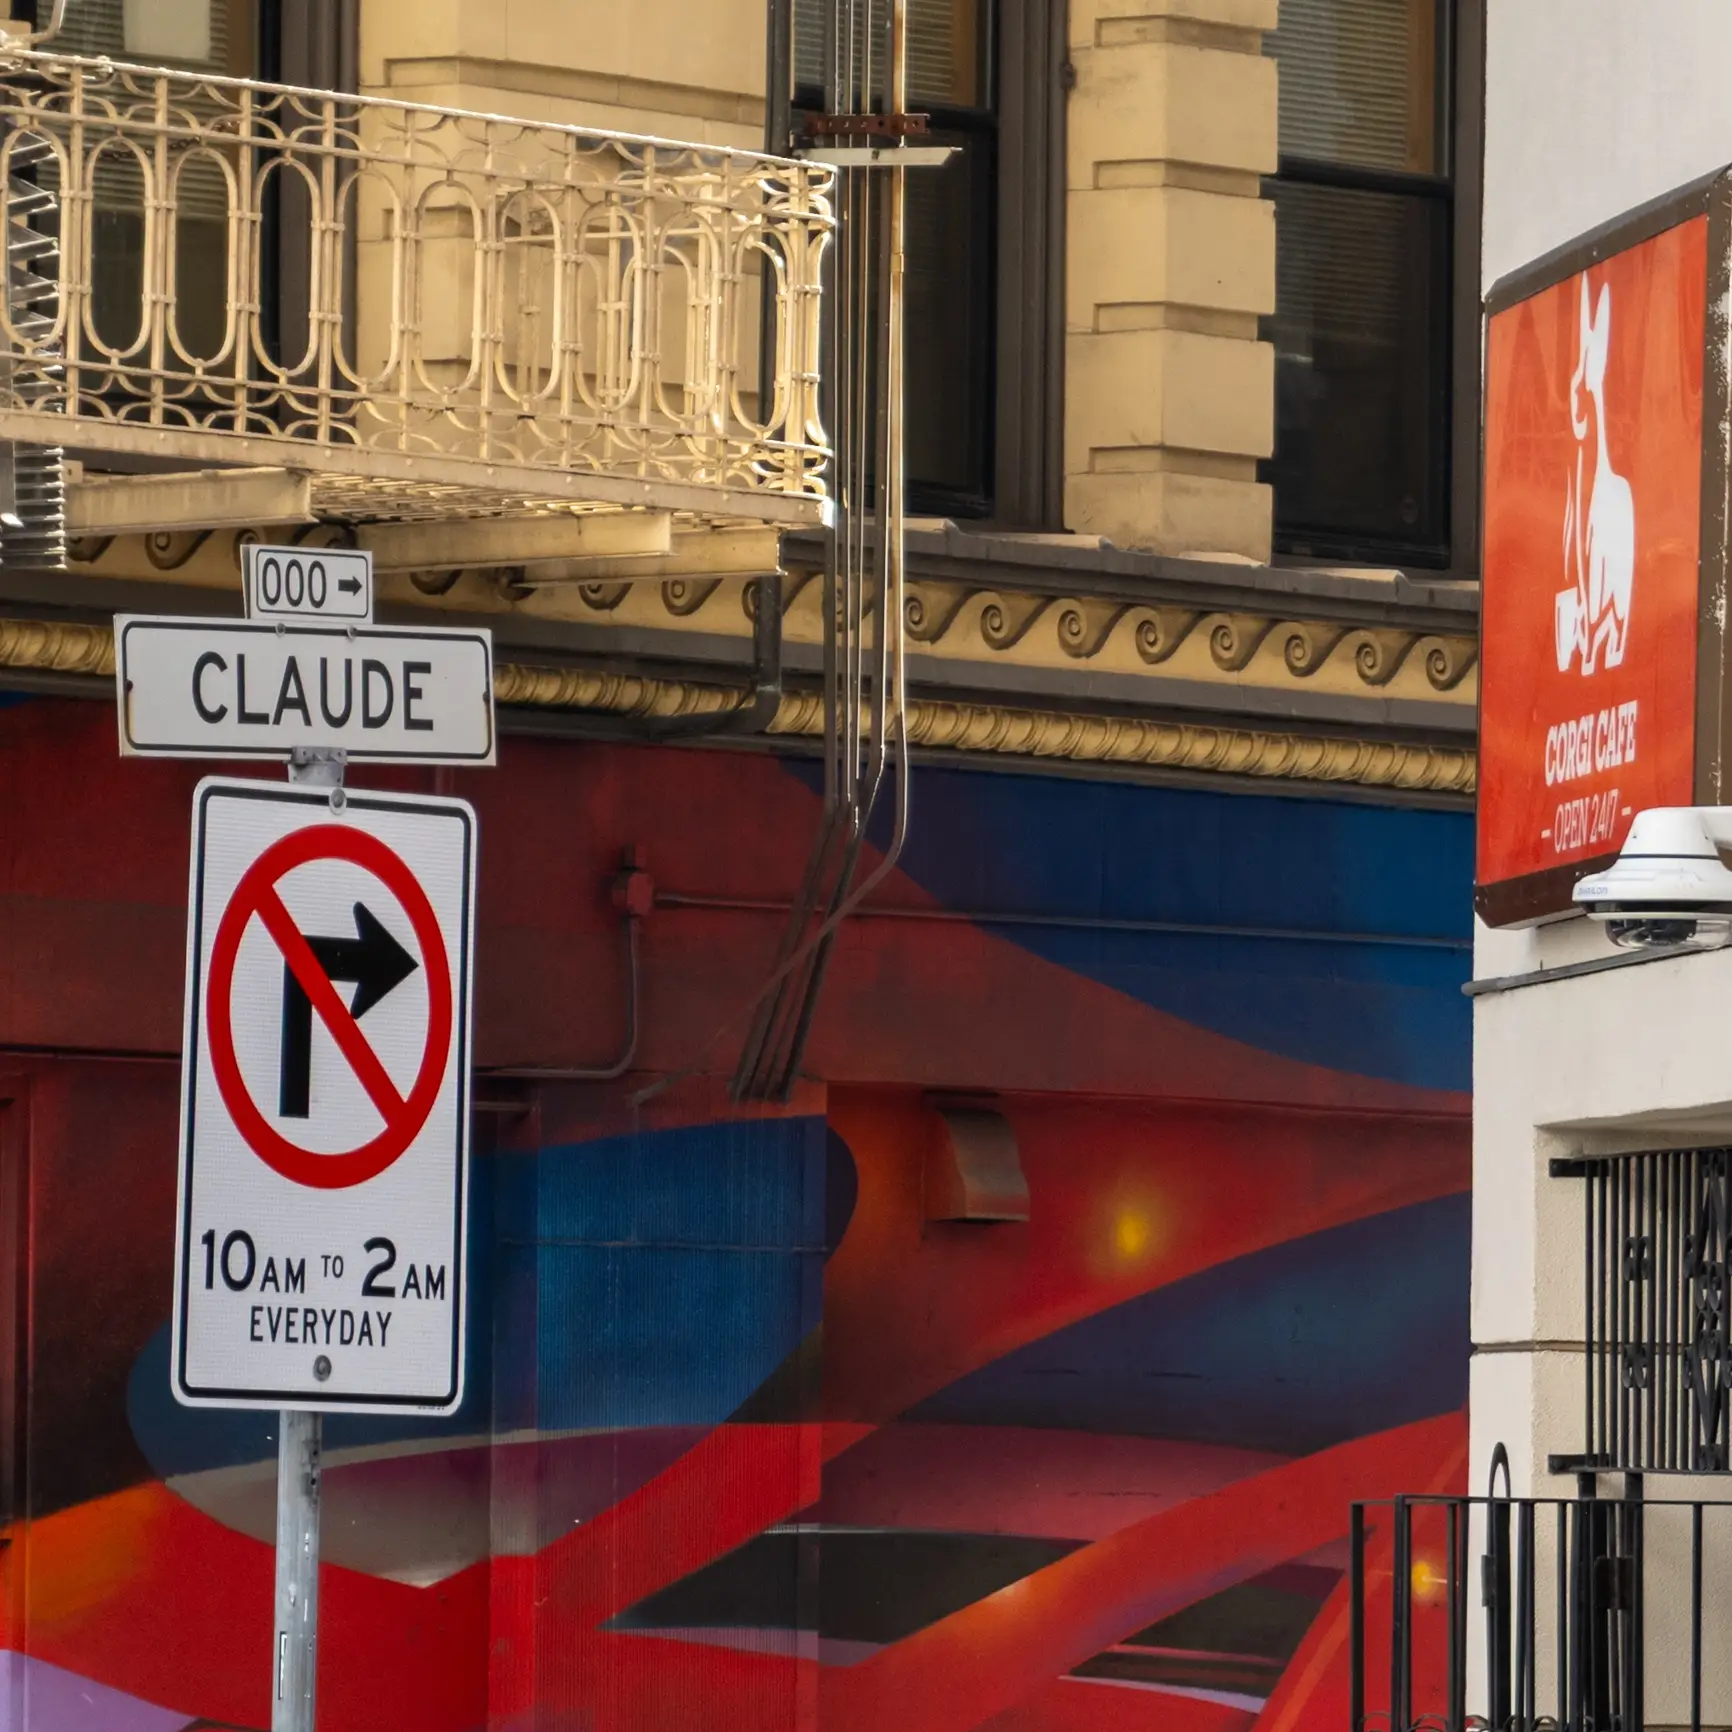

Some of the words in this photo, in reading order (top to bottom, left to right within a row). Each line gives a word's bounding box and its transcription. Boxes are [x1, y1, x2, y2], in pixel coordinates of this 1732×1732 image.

[262, 557, 327, 609] 000
[192, 651, 434, 731] CLAUDE
[1545, 714, 1595, 787] CORGI
[1594, 700, 1639, 772] CAFE
[1554, 796, 1590, 853] OPEN
[1589, 788, 1619, 845] 24/7
[320, 1255, 344, 1278] TO
[250, 1305, 392, 1347] EVERYDAY
